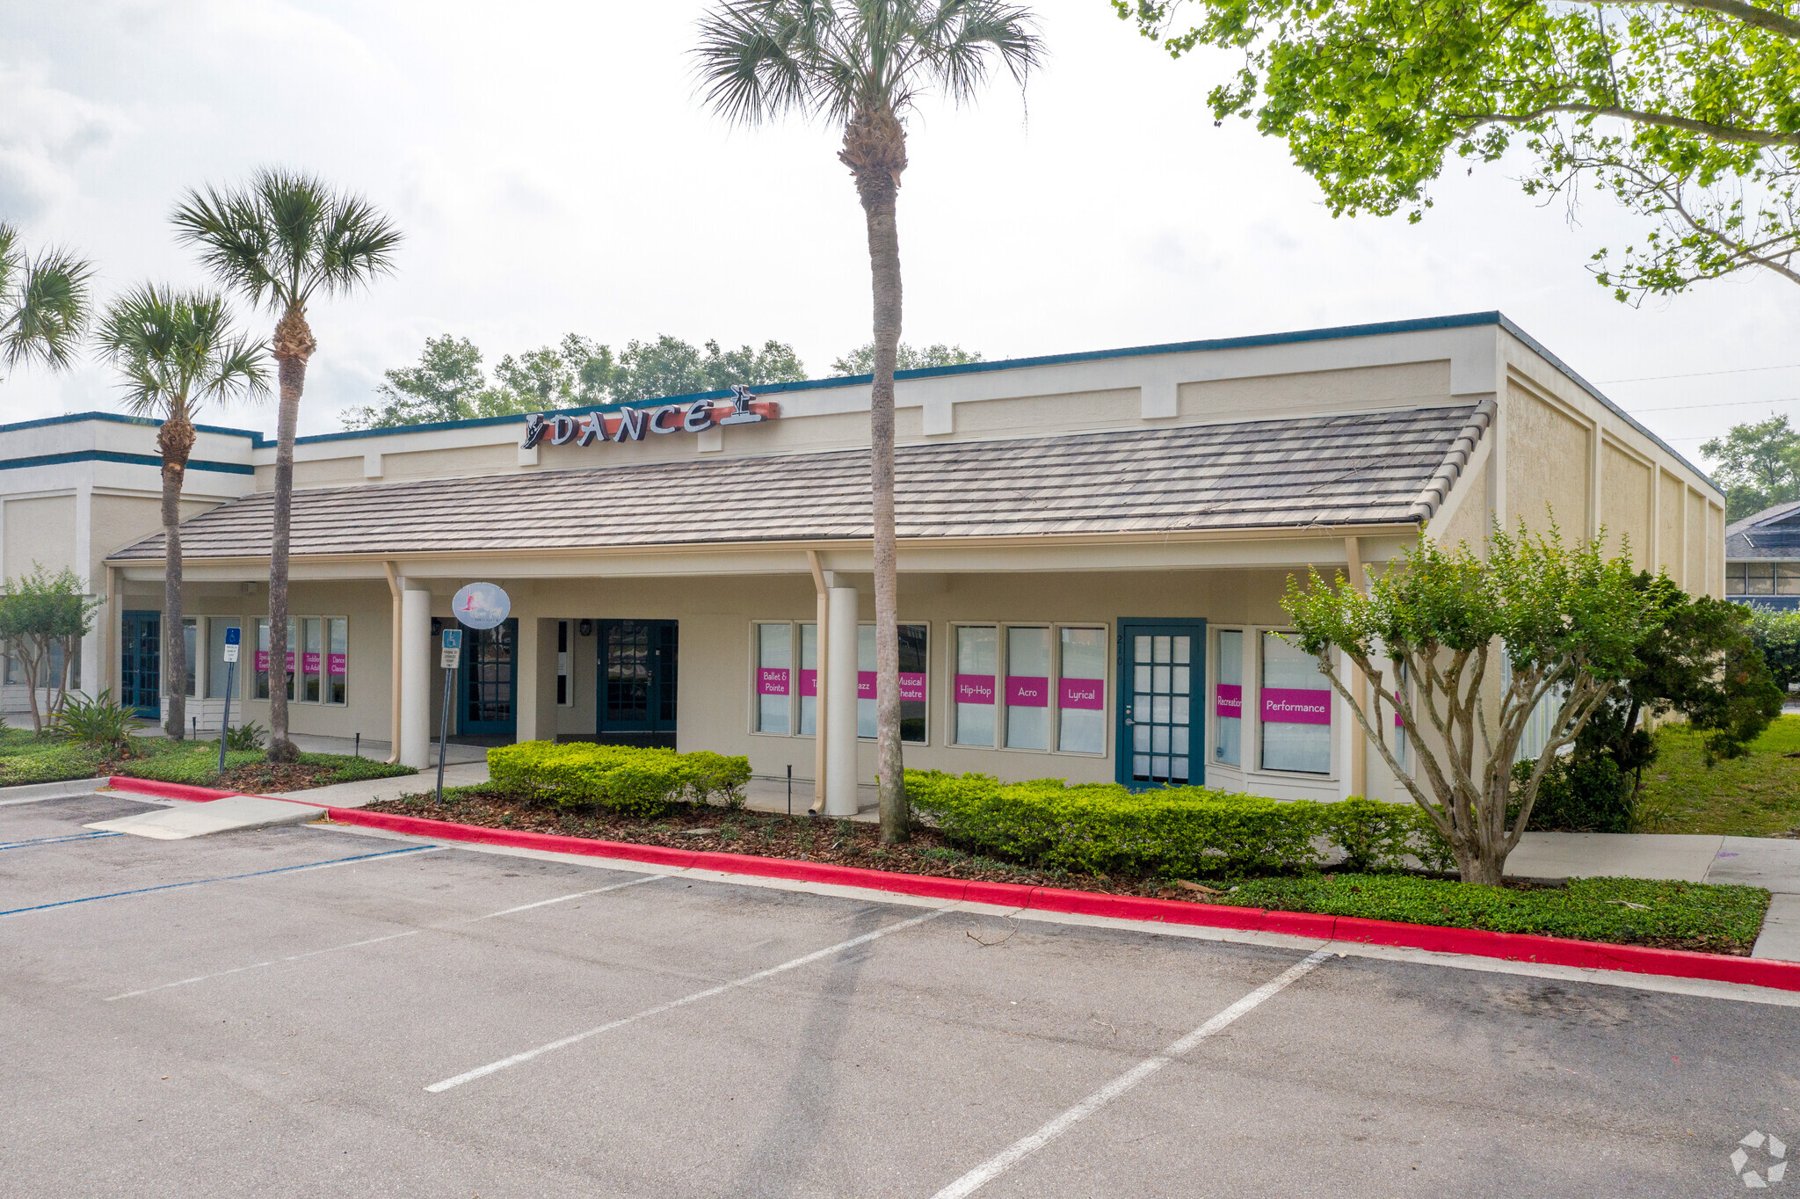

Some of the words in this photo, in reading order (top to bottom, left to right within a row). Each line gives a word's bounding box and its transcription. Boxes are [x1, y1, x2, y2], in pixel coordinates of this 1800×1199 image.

[551, 399, 714, 447] DANCE
[763, 672, 781, 681] Ballet
[781, 672, 787, 681] &
[765, 684, 785, 693] Pointe
[899, 688, 922, 698] heatre
[960, 684, 991, 698] Hip-Hop
[1018, 687, 1037, 697] Acro
[1068, 689, 1095, 701] Lyrical
[1266, 699, 1325, 713] Performance
